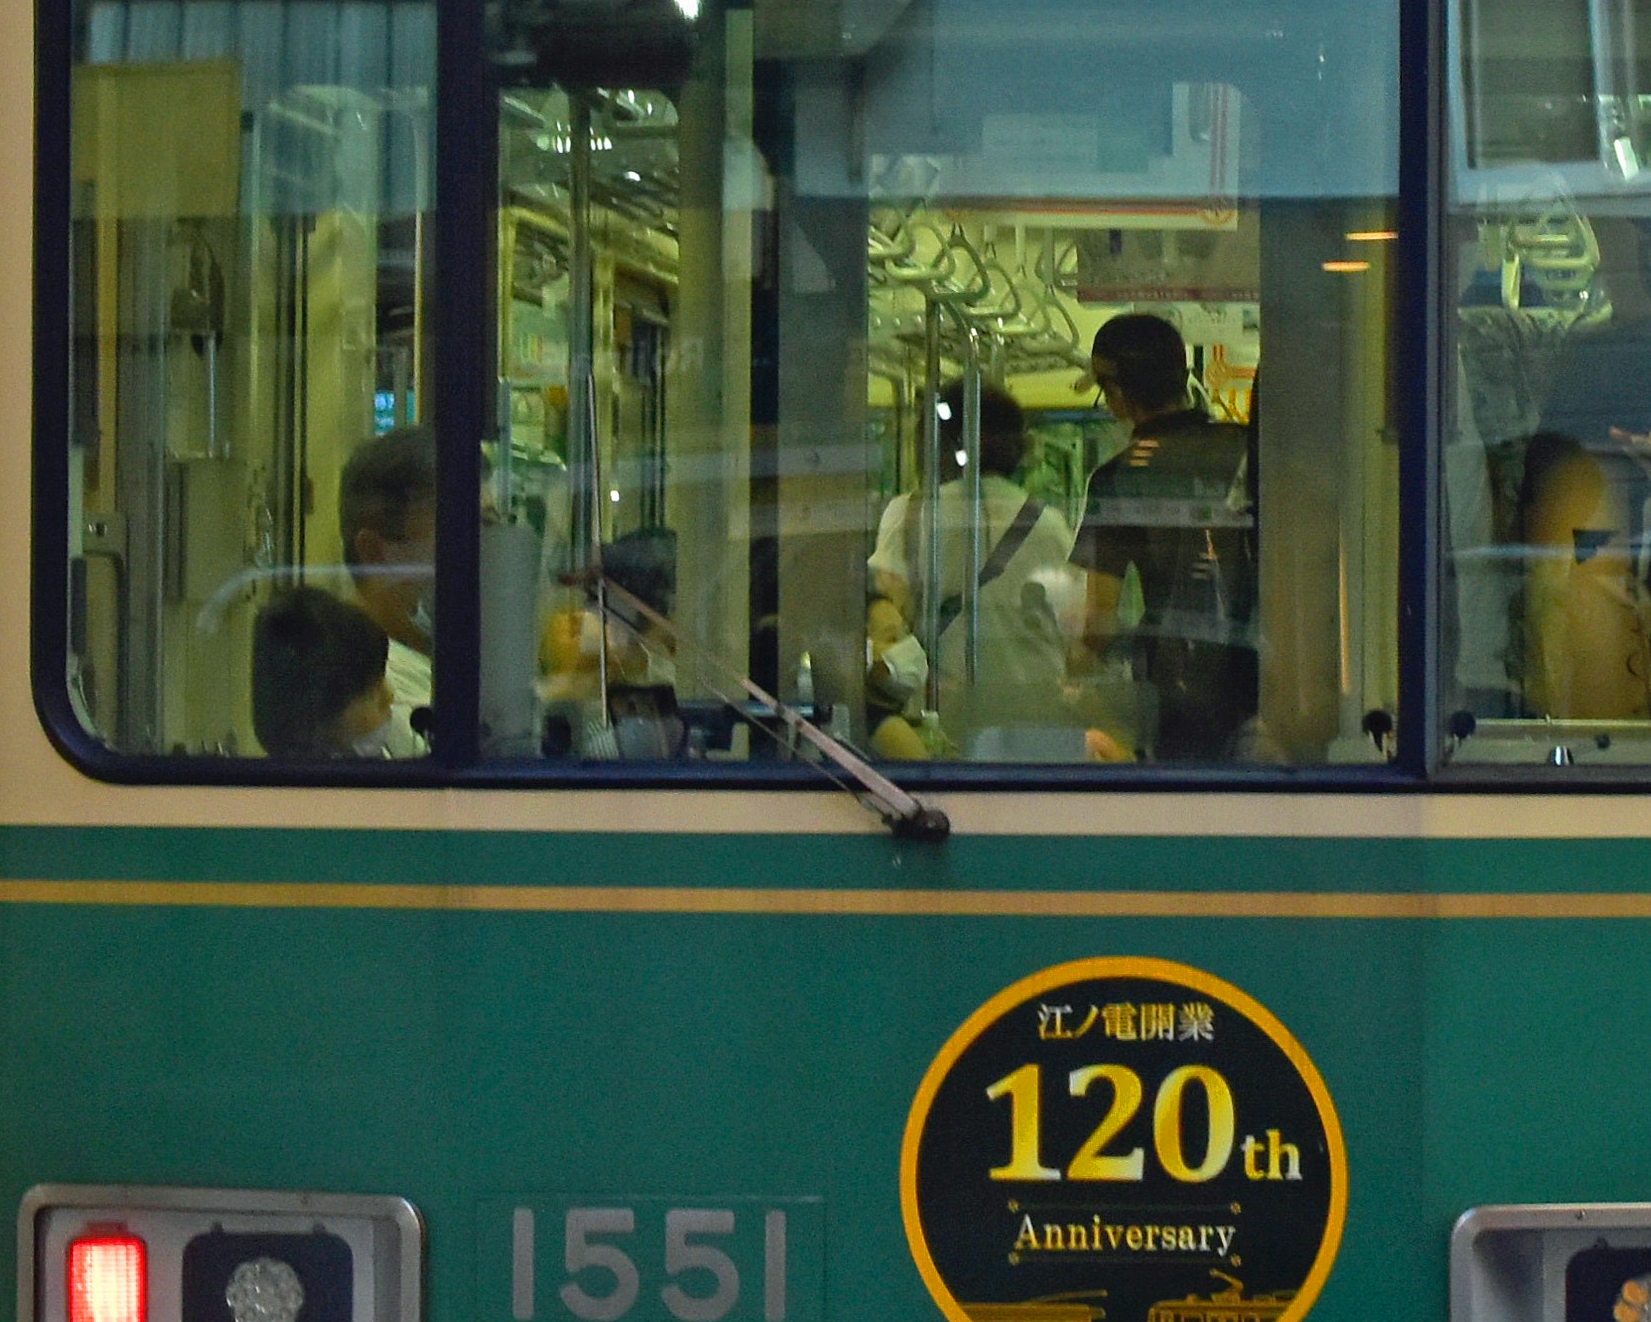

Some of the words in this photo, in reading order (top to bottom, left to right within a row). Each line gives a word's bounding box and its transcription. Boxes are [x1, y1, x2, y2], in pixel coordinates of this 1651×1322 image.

[1036, 1001, 1216, 1042] 江ノ電開業
[985, 1063, 1304, 1183] 120th
[1013, 1214, 1237, 1258] Anniversary
